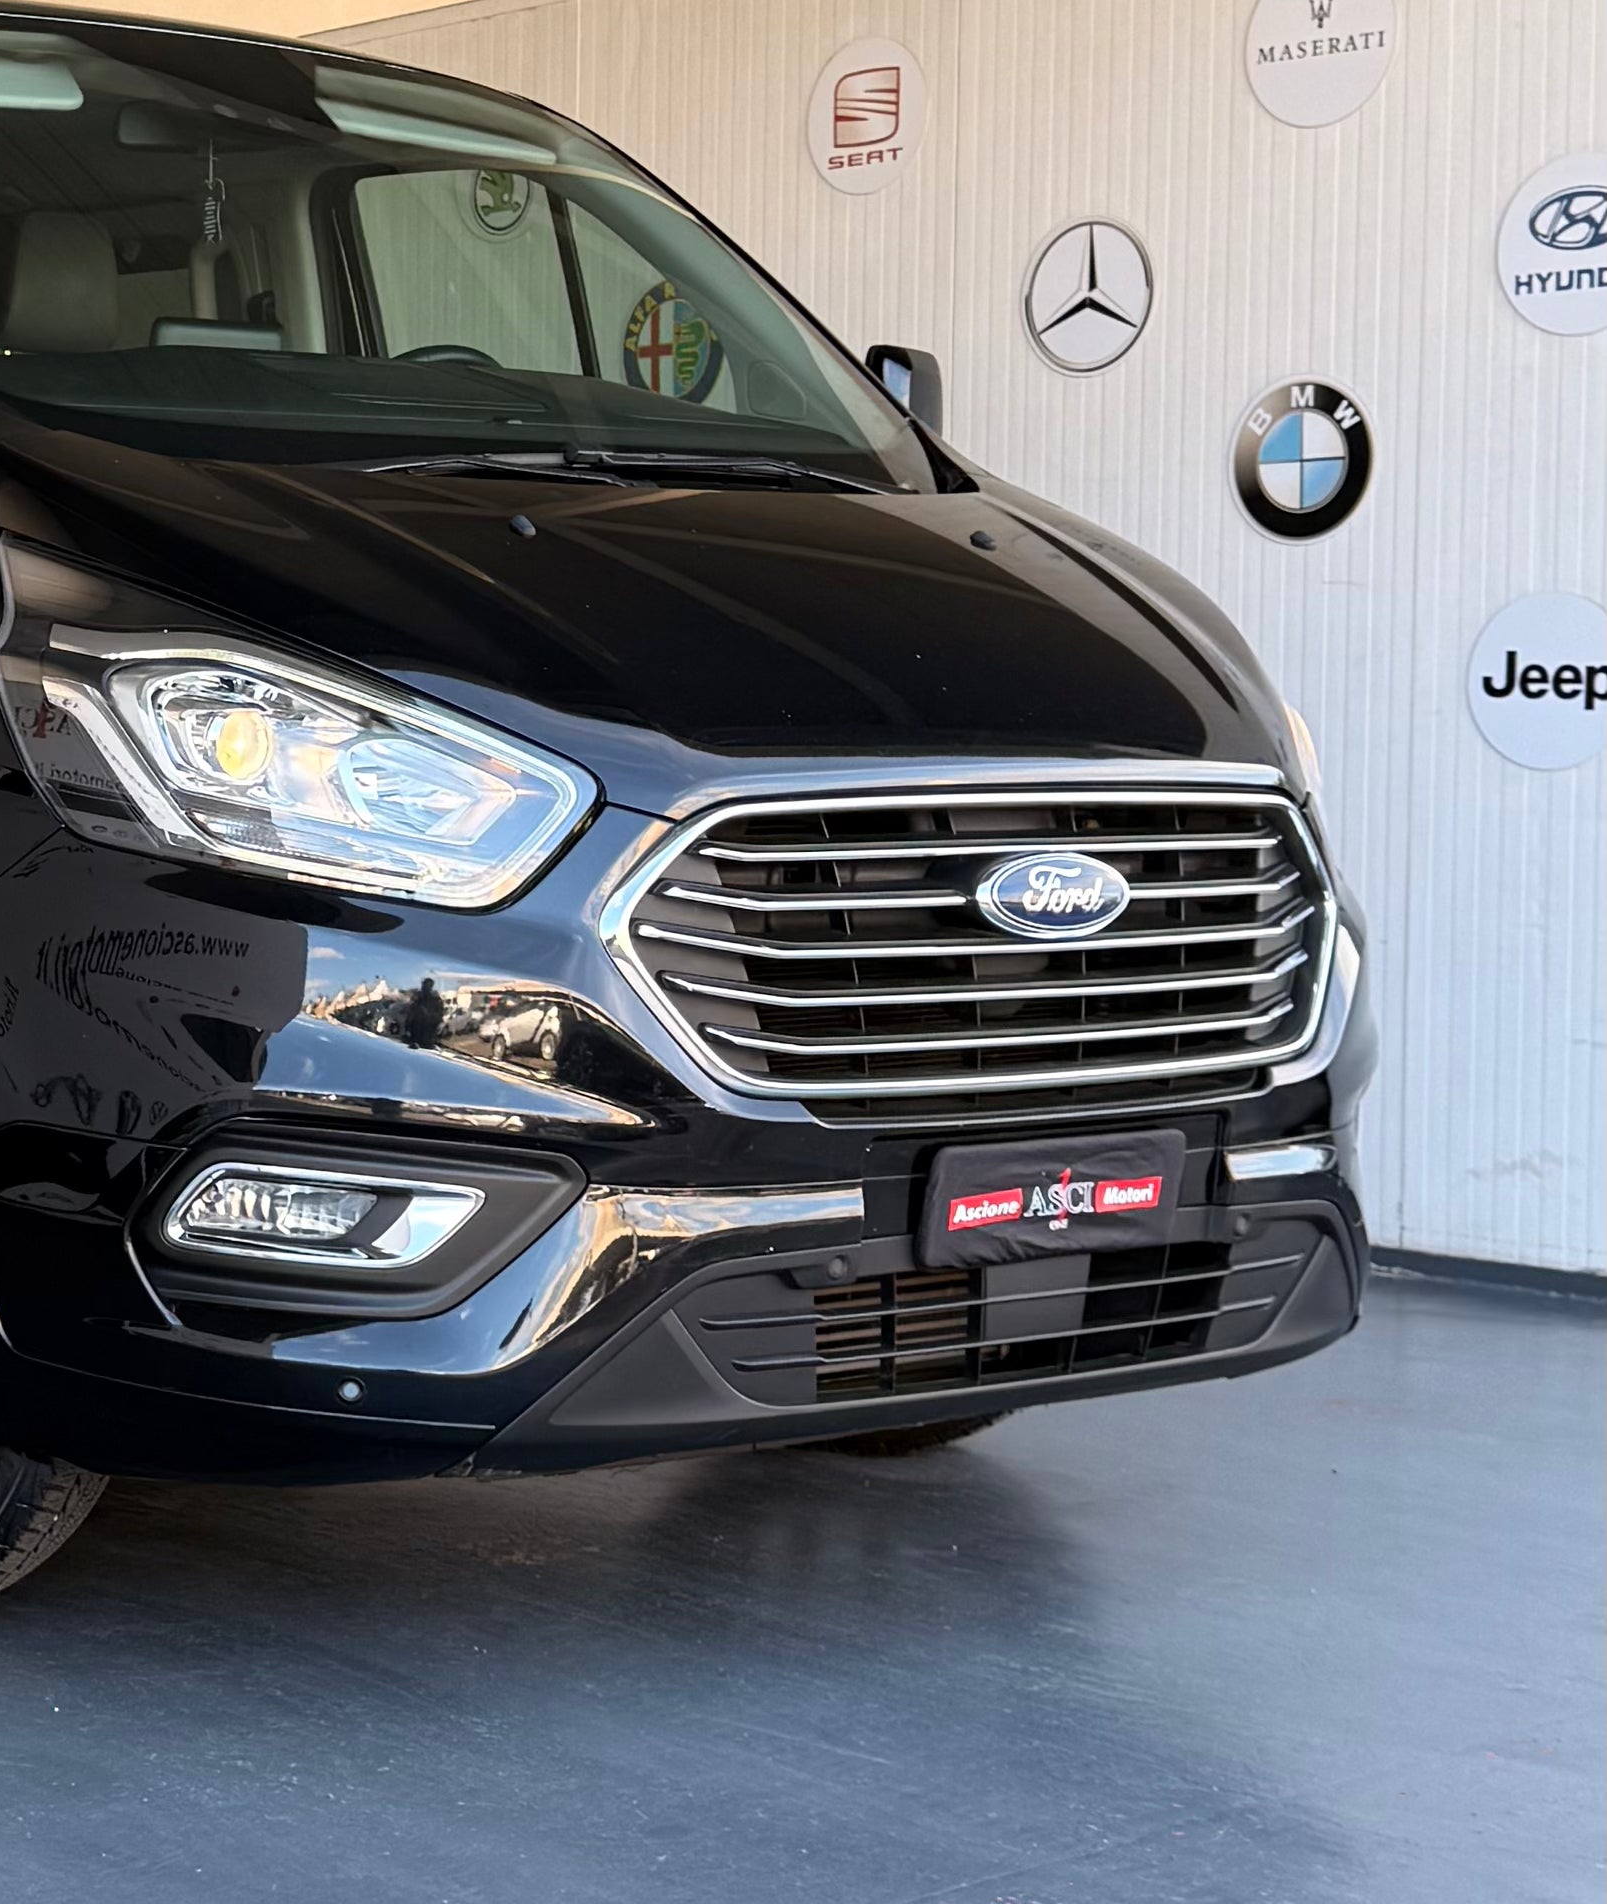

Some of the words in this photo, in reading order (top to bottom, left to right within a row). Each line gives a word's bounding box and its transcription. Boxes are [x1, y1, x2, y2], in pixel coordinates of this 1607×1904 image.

[1257, 30, 1385, 65] MASERATI
[827, 147, 903, 170] SEAT
[625, 295, 658, 352] ALFA
[1247, 384, 1362, 436] BMW
[1482, 650, 1607, 711] Jeep
[1022, 865, 1104, 914] Ford
[953, 1200, 1022, 1224] Ascione
[1023, 1181, 1095, 1217] ASCI
[1103, 1183, 1154, 1206] Motori
